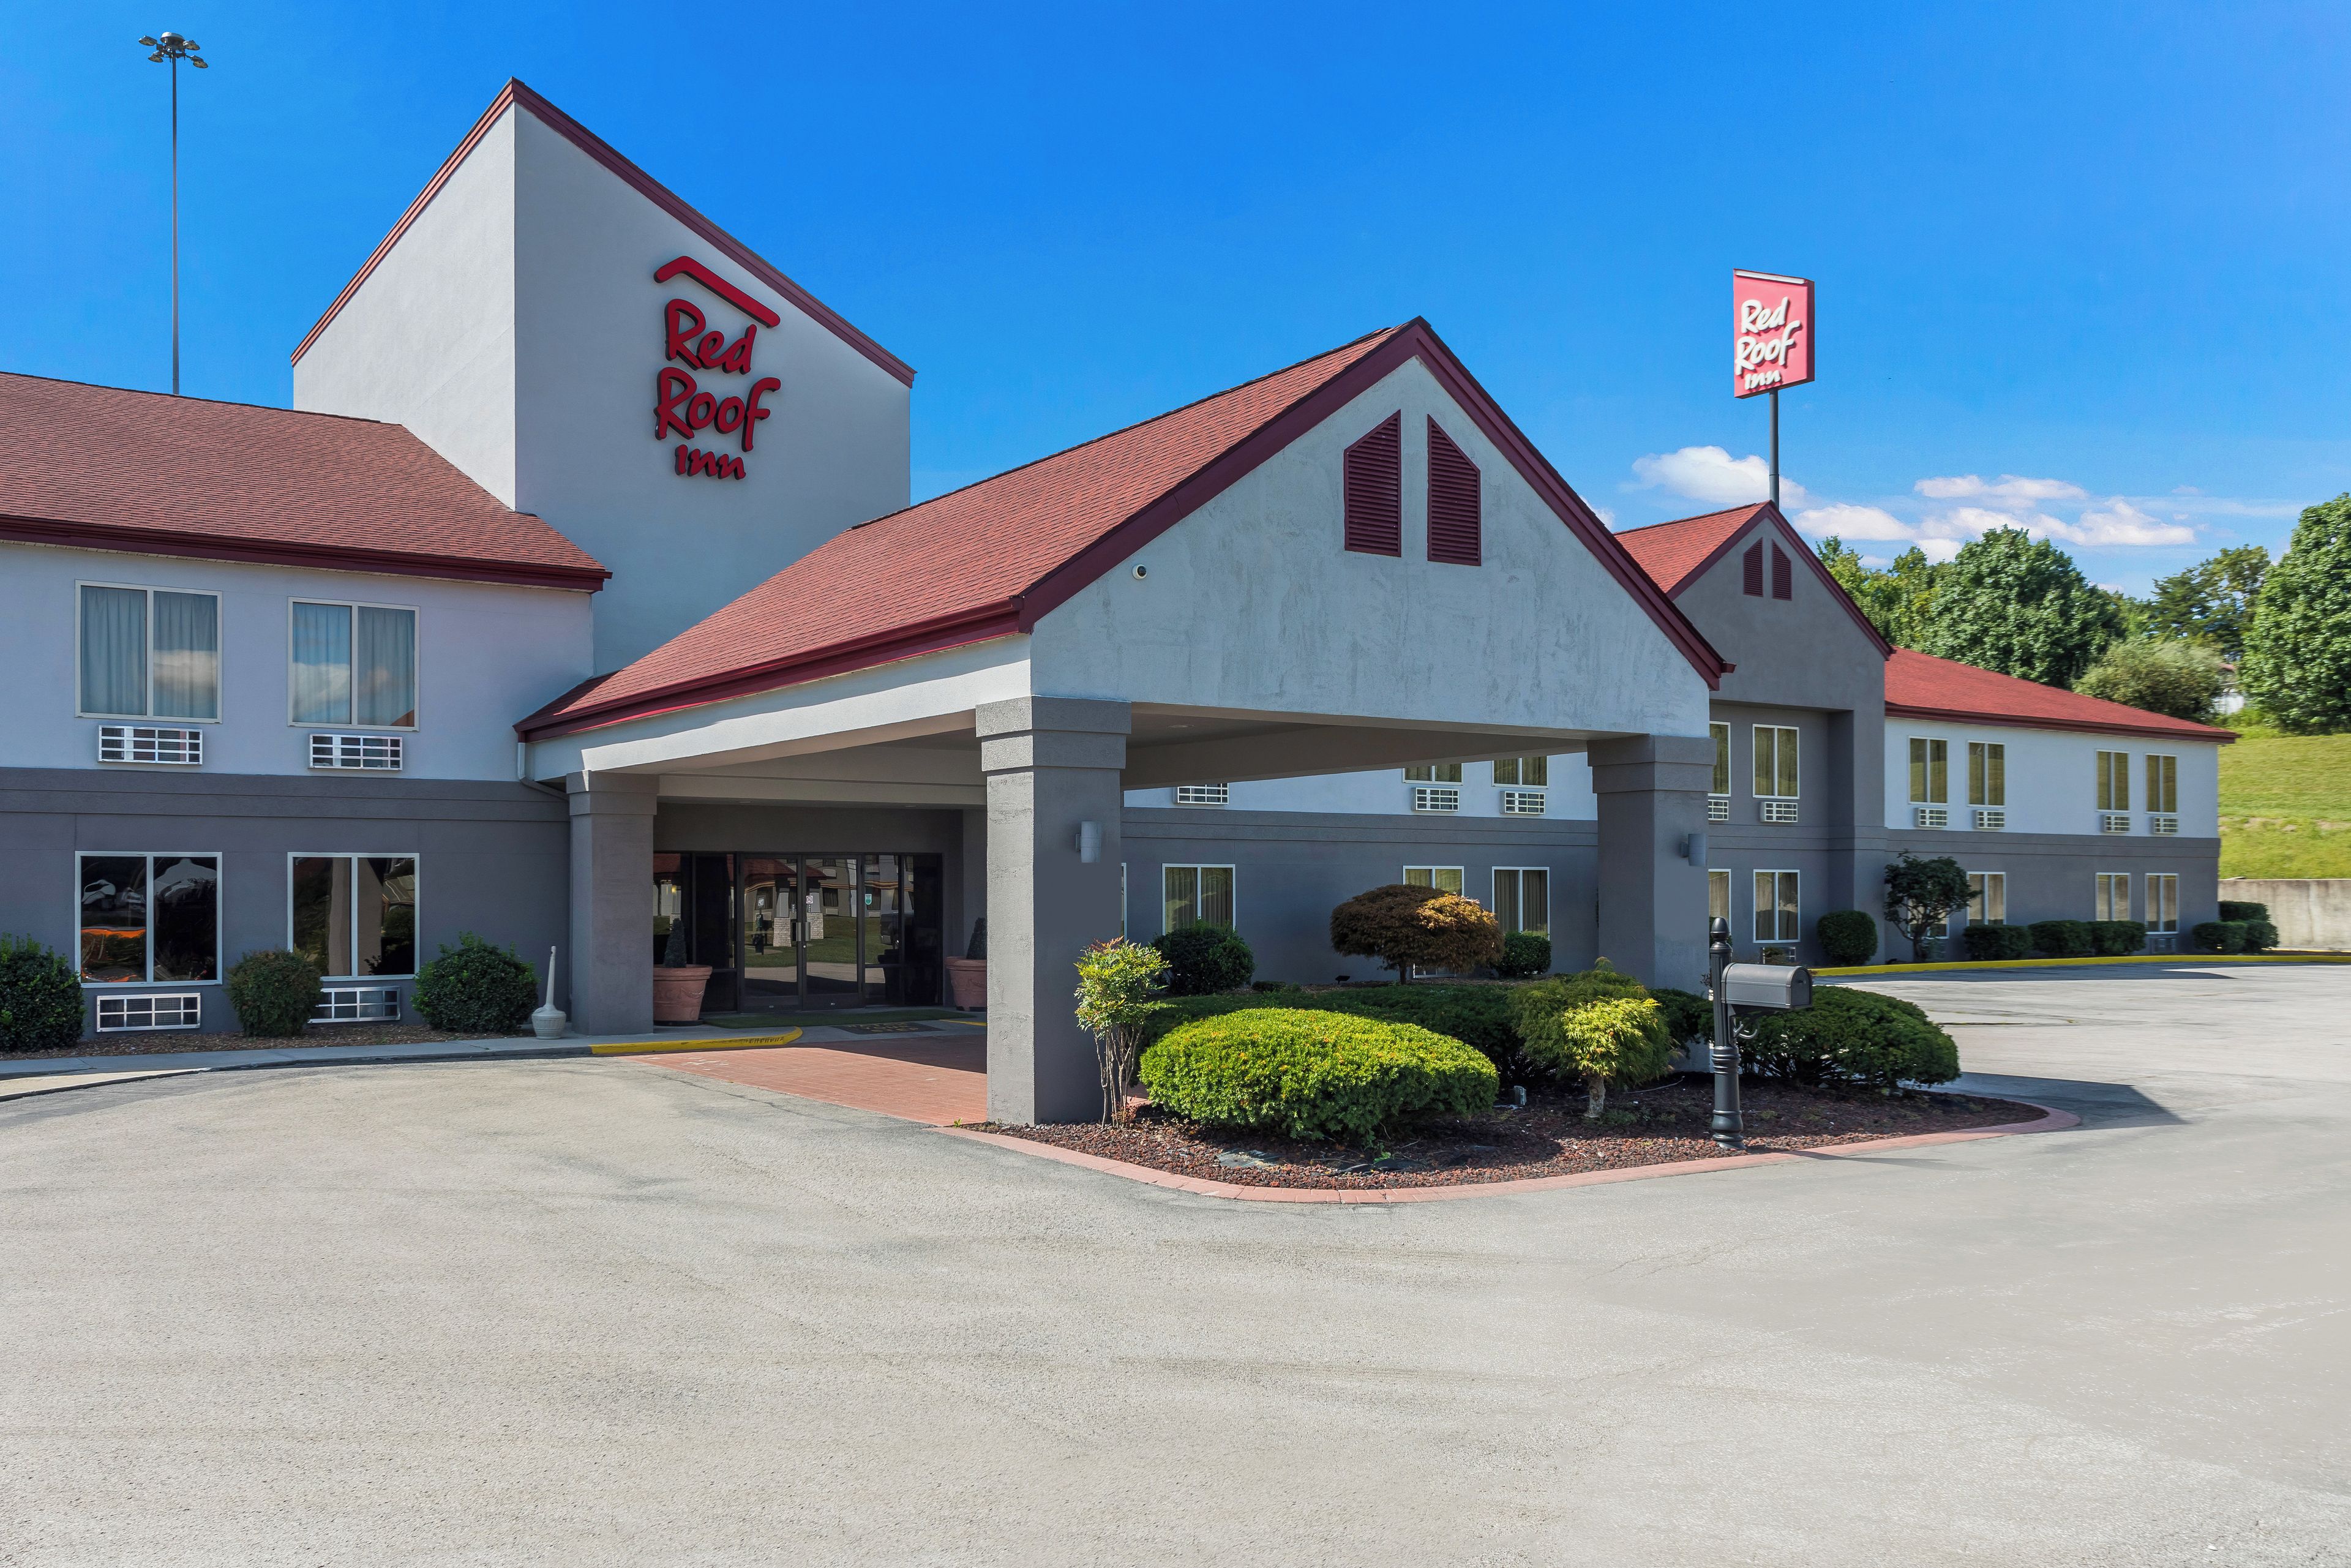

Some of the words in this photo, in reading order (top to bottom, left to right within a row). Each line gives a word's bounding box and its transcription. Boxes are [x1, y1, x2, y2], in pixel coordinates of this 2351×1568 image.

[665, 298, 757, 375] Red
[1735, 320, 1800, 375] Roof
[1741, 297, 1788, 333] Red
[654, 367, 781, 452] Roof
